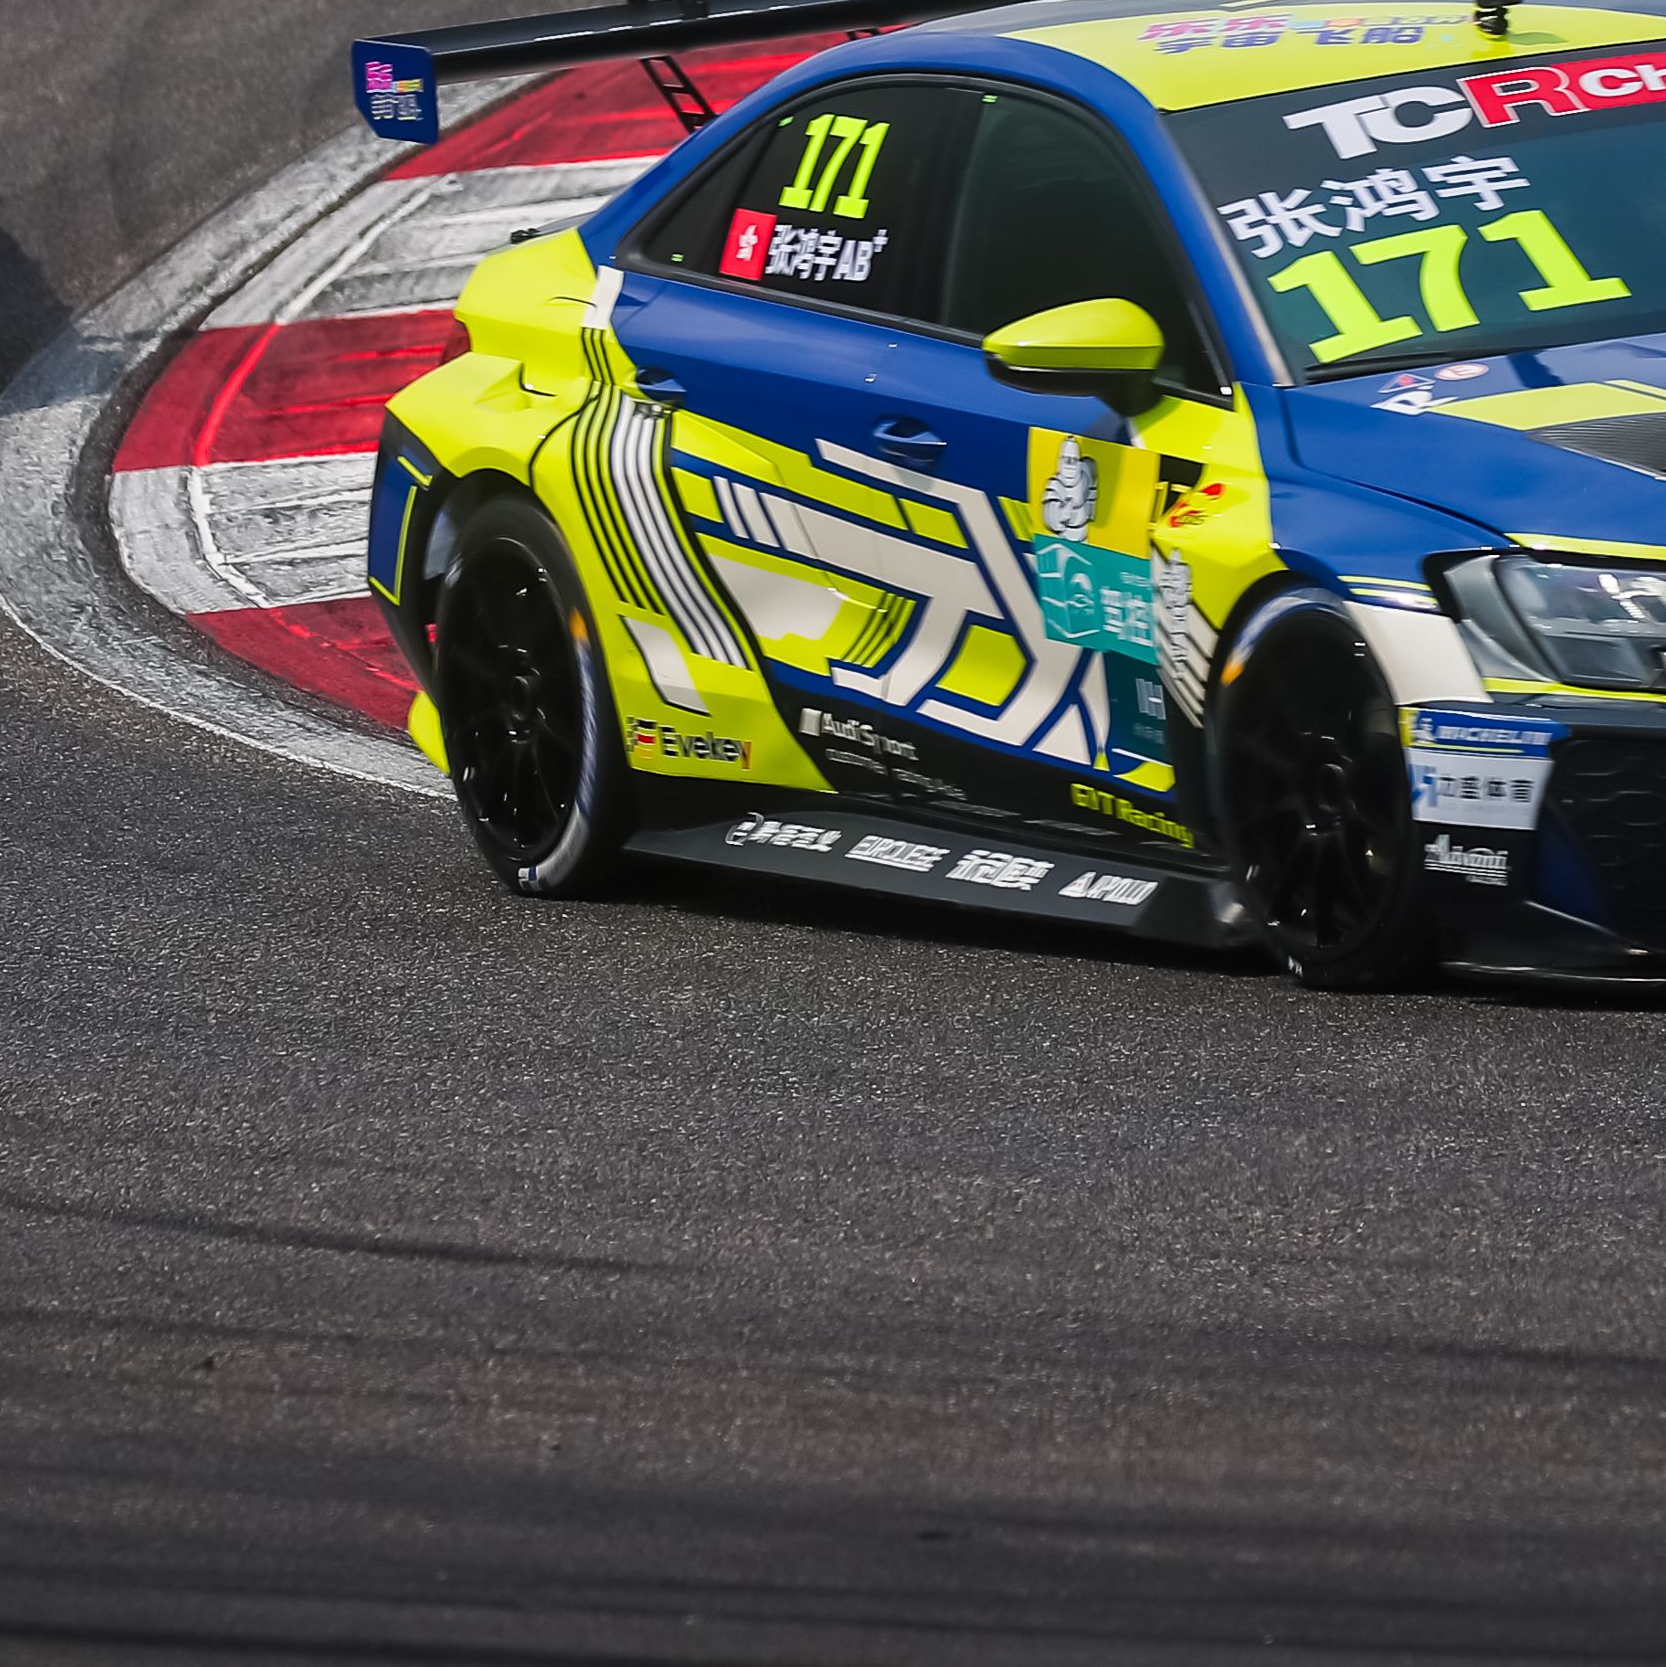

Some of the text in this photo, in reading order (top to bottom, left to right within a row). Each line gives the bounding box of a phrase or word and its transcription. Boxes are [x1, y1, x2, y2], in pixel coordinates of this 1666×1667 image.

[1283, 62, 1581, 160] TCR
[779, 114, 890, 219] 171
[1219, 156, 1531, 259] 张鸿宇
[1267, 209, 1633, 364] 171
